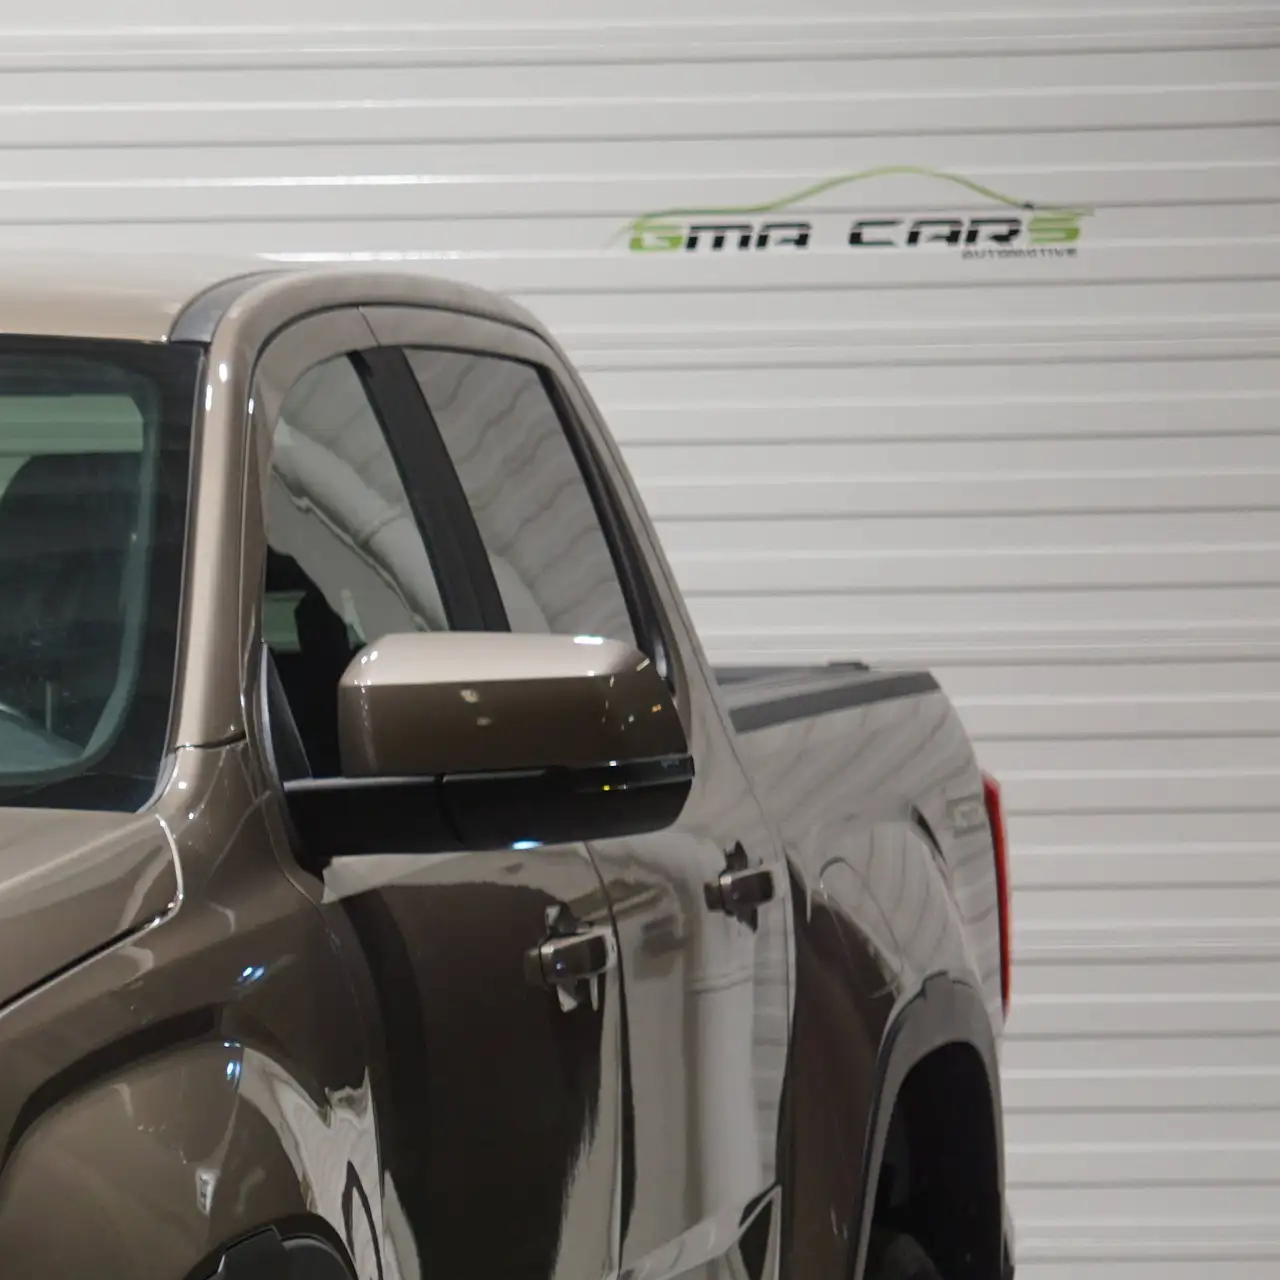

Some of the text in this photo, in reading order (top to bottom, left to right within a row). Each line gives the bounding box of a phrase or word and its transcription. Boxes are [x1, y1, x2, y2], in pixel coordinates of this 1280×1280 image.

[630, 215, 1080, 252] GMA CARS
[961, 246, 1078, 260] AUTOMOTIVE
